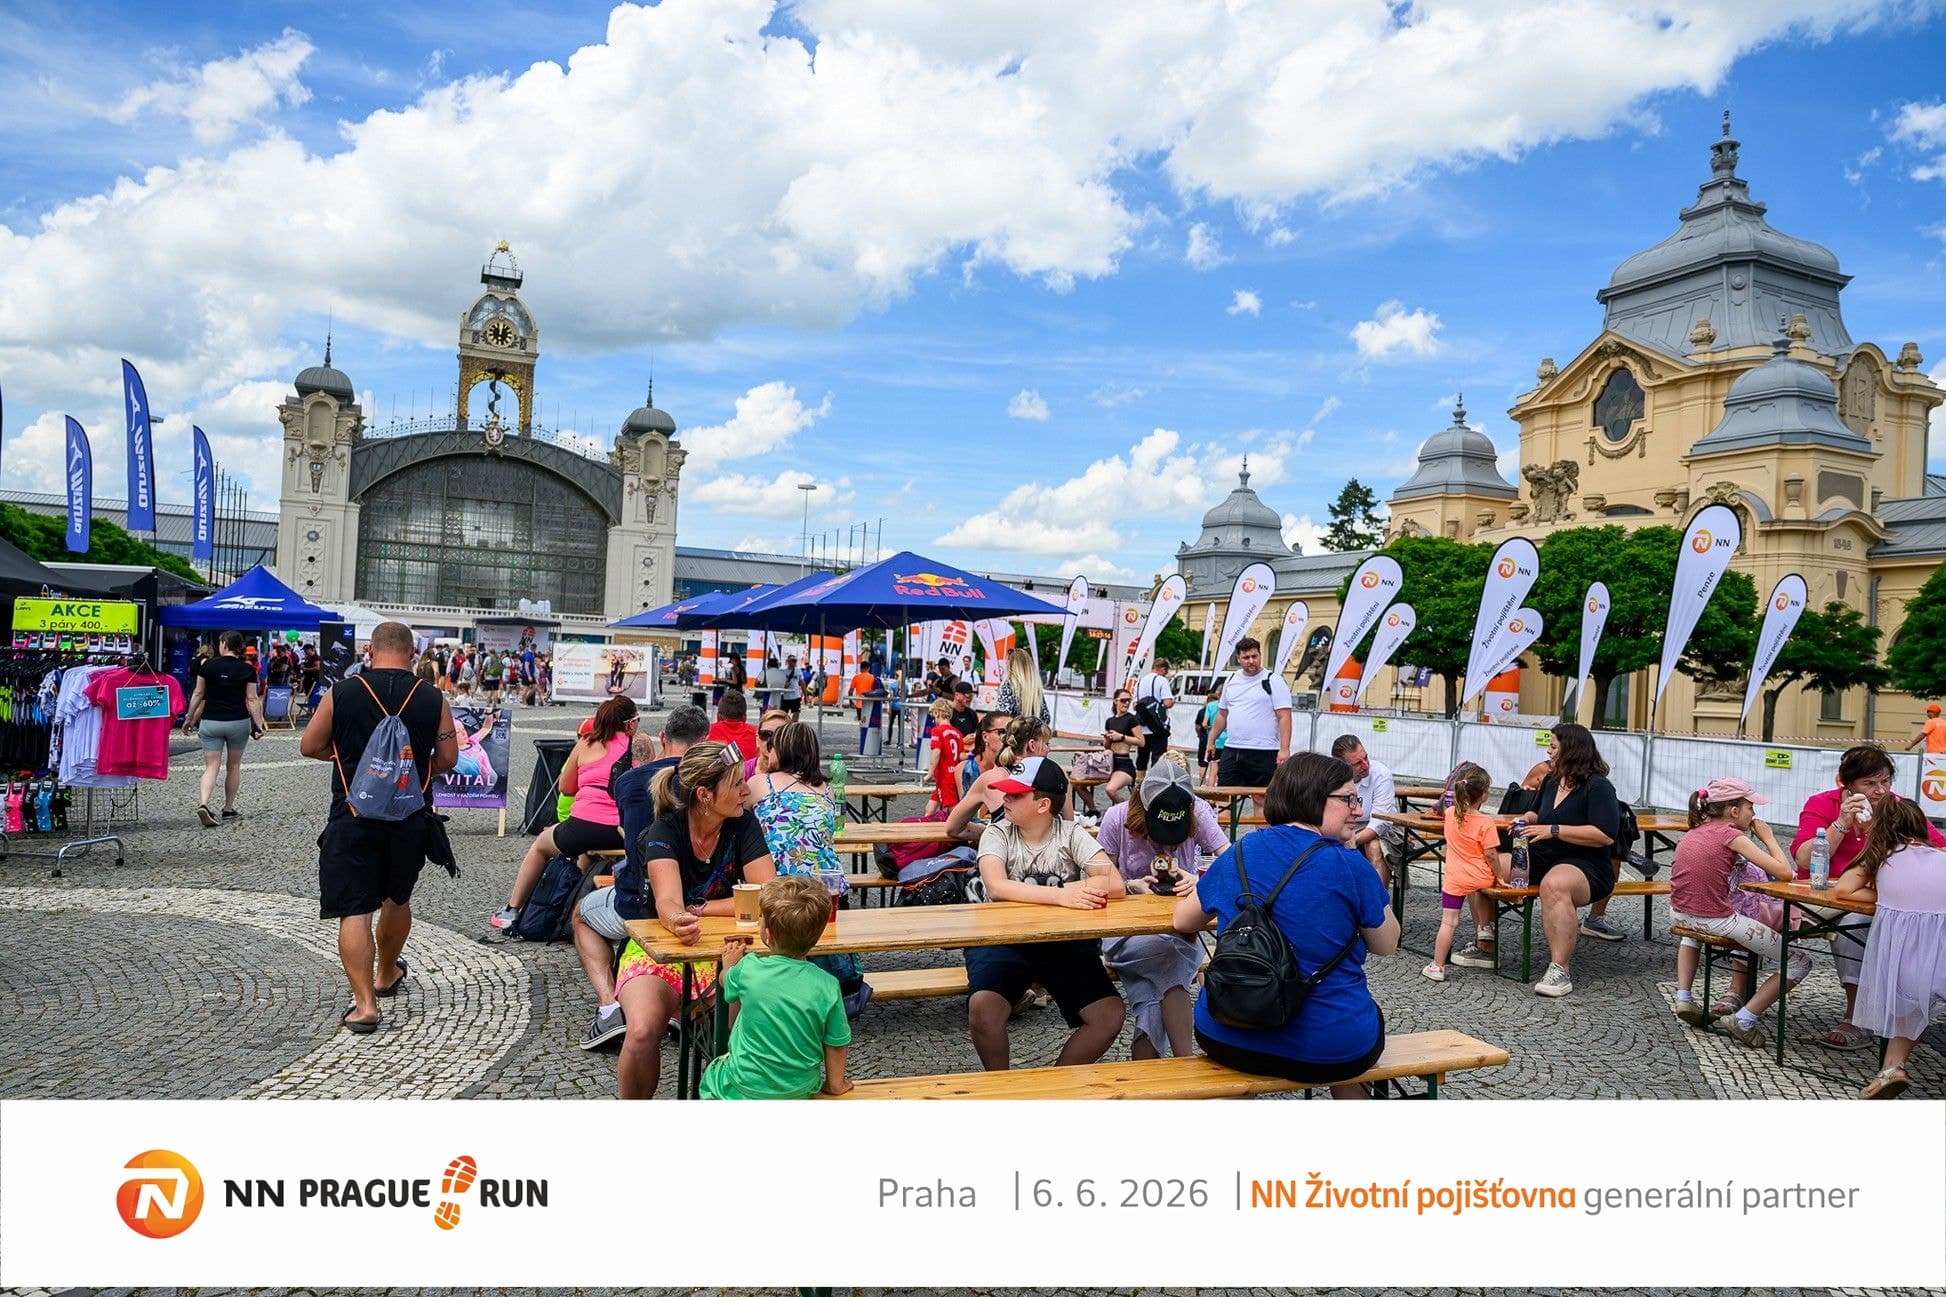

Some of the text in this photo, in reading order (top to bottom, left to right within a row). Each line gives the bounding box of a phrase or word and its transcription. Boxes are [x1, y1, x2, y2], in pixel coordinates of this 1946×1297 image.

[1715, 538, 1731, 548] NN
[1517, 567, 1531, 577] NN
[1257, 583, 1269, 591] NN
[1381, 579, 1395, 587] NN
[1697, 571, 1716, 599] Penze
[893, 584, 986, 599] Red Bull
[1790, 599, 1800, 607] NN
[51, 604, 101, 617] AKCE
[40, 619, 47, 627] 3
[49, 619, 77, 631] páry
[1482, 594, 1517, 649] Životní pojištění
[1524, 627, 1535, 635] NN
[939, 641, 962, 656] NN
[949, 738, 958, 761] 9
[445, 774, 495, 786] VITAL
